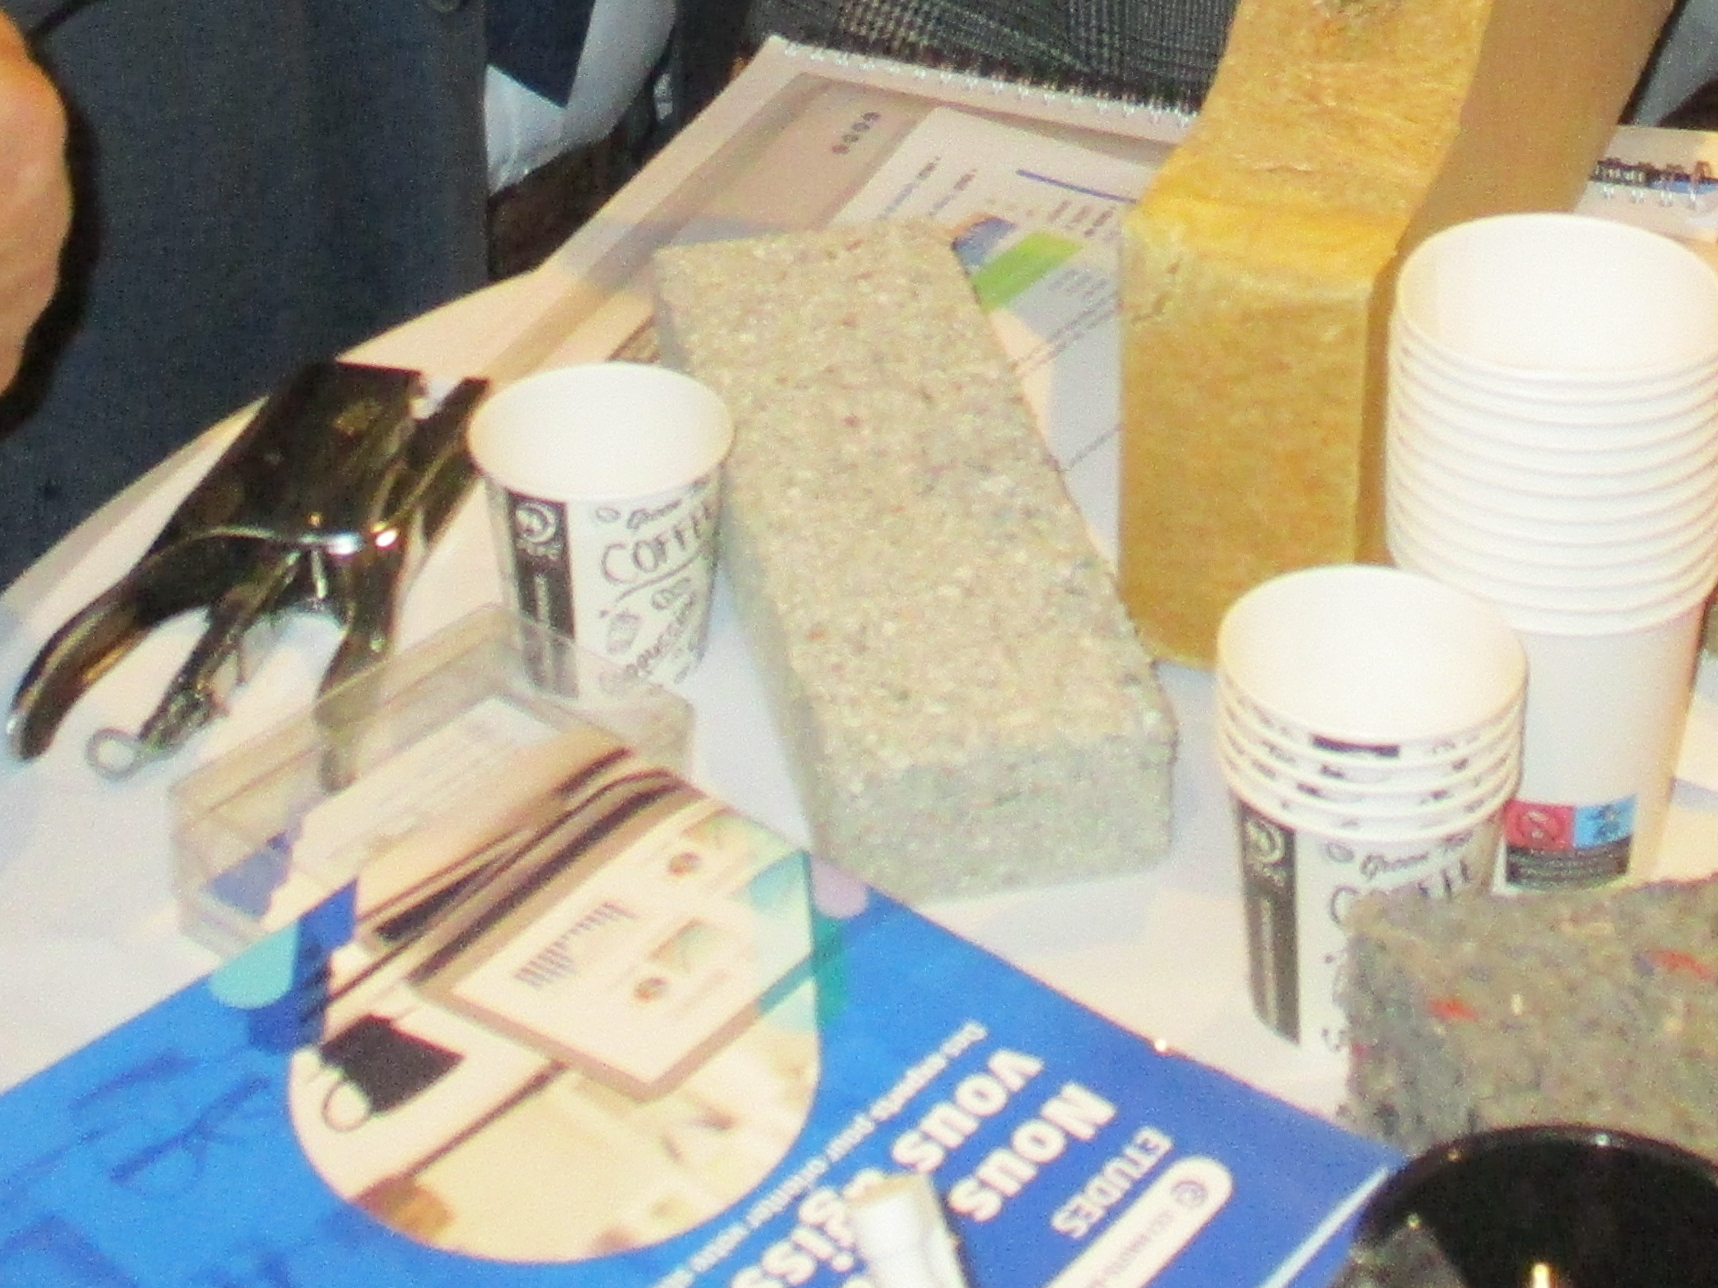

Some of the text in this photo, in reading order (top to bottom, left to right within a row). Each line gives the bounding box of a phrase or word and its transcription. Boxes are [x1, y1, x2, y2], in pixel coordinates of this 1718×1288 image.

[891, 1047, 1045, 1175] vous
[947, 1080, 1117, 1223] Nous
[1050, 1126, 1175, 1240] ETUDES
